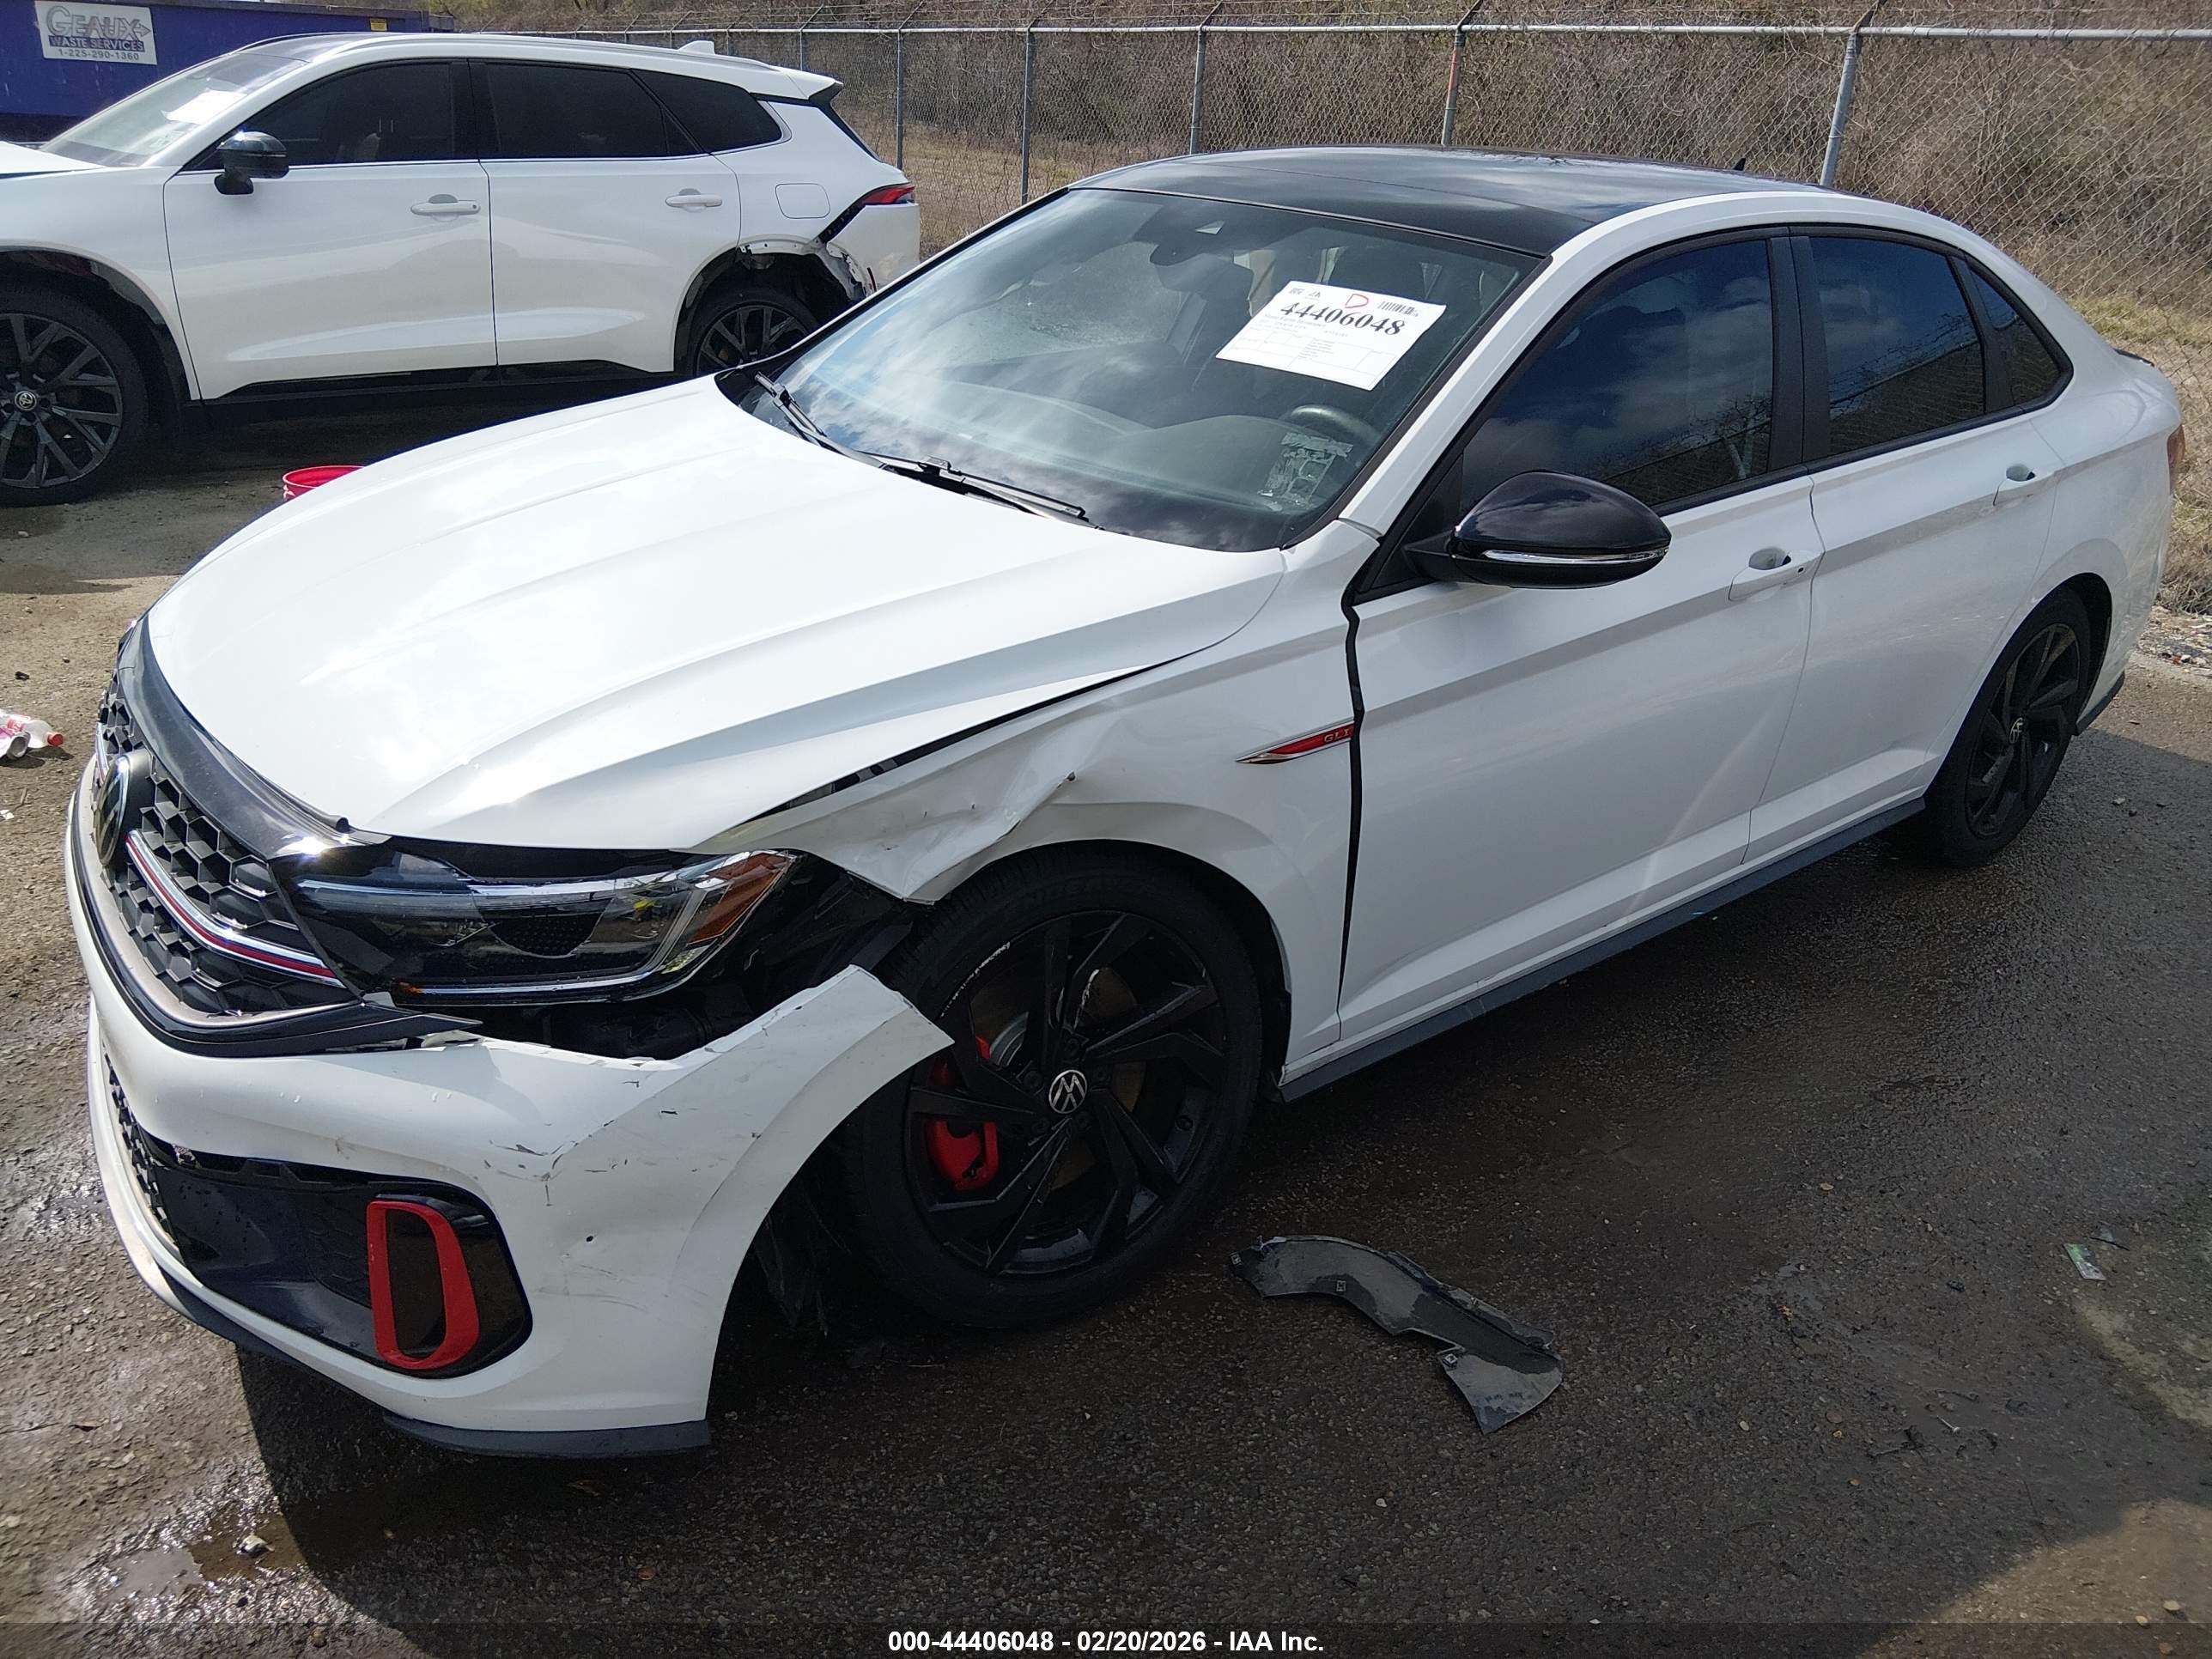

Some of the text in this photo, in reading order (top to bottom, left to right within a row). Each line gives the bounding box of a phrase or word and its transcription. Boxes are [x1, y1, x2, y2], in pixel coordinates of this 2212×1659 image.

[46, 5, 140, 41] GEAUX
[51, 36, 143, 51] WASTE SERVICES
[58, 49, 139, 60] 1-225-290-1360
[1280, 302, 1406, 336] 44406048
[1323, 728, 1350, 744] GLI
